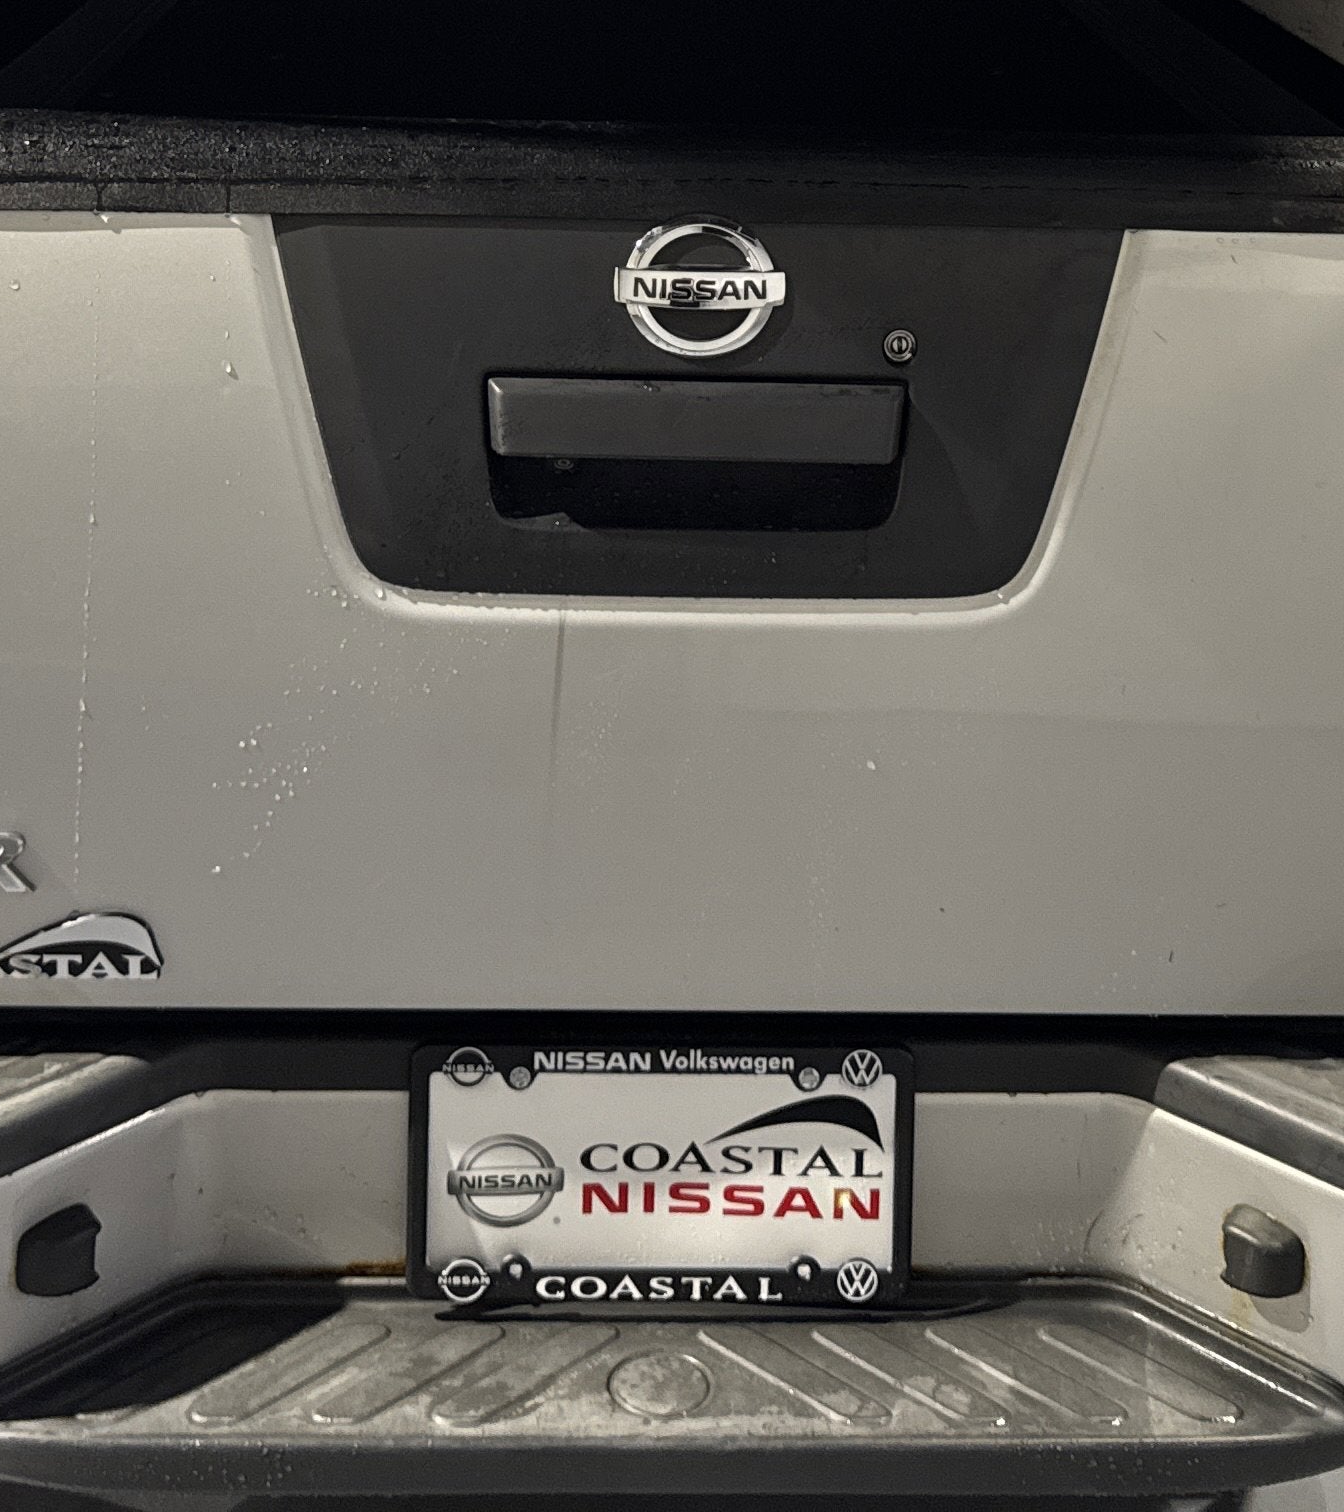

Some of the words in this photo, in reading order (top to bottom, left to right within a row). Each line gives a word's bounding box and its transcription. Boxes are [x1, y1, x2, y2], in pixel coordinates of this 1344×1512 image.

[632, 276, 767, 301] NISSAN
[442, 1063, 495, 1073] NISSAN
[533, 1051, 652, 1072] NISSAN
[659, 1048, 795, 1074] Volkswagen
[580, 1141, 884, 1179] COASTAL
[458, 1172, 553, 1190] NISSAN
[581, 1181, 881, 1221] NISSAN
[535, 1274, 783, 1302] COASTAL
